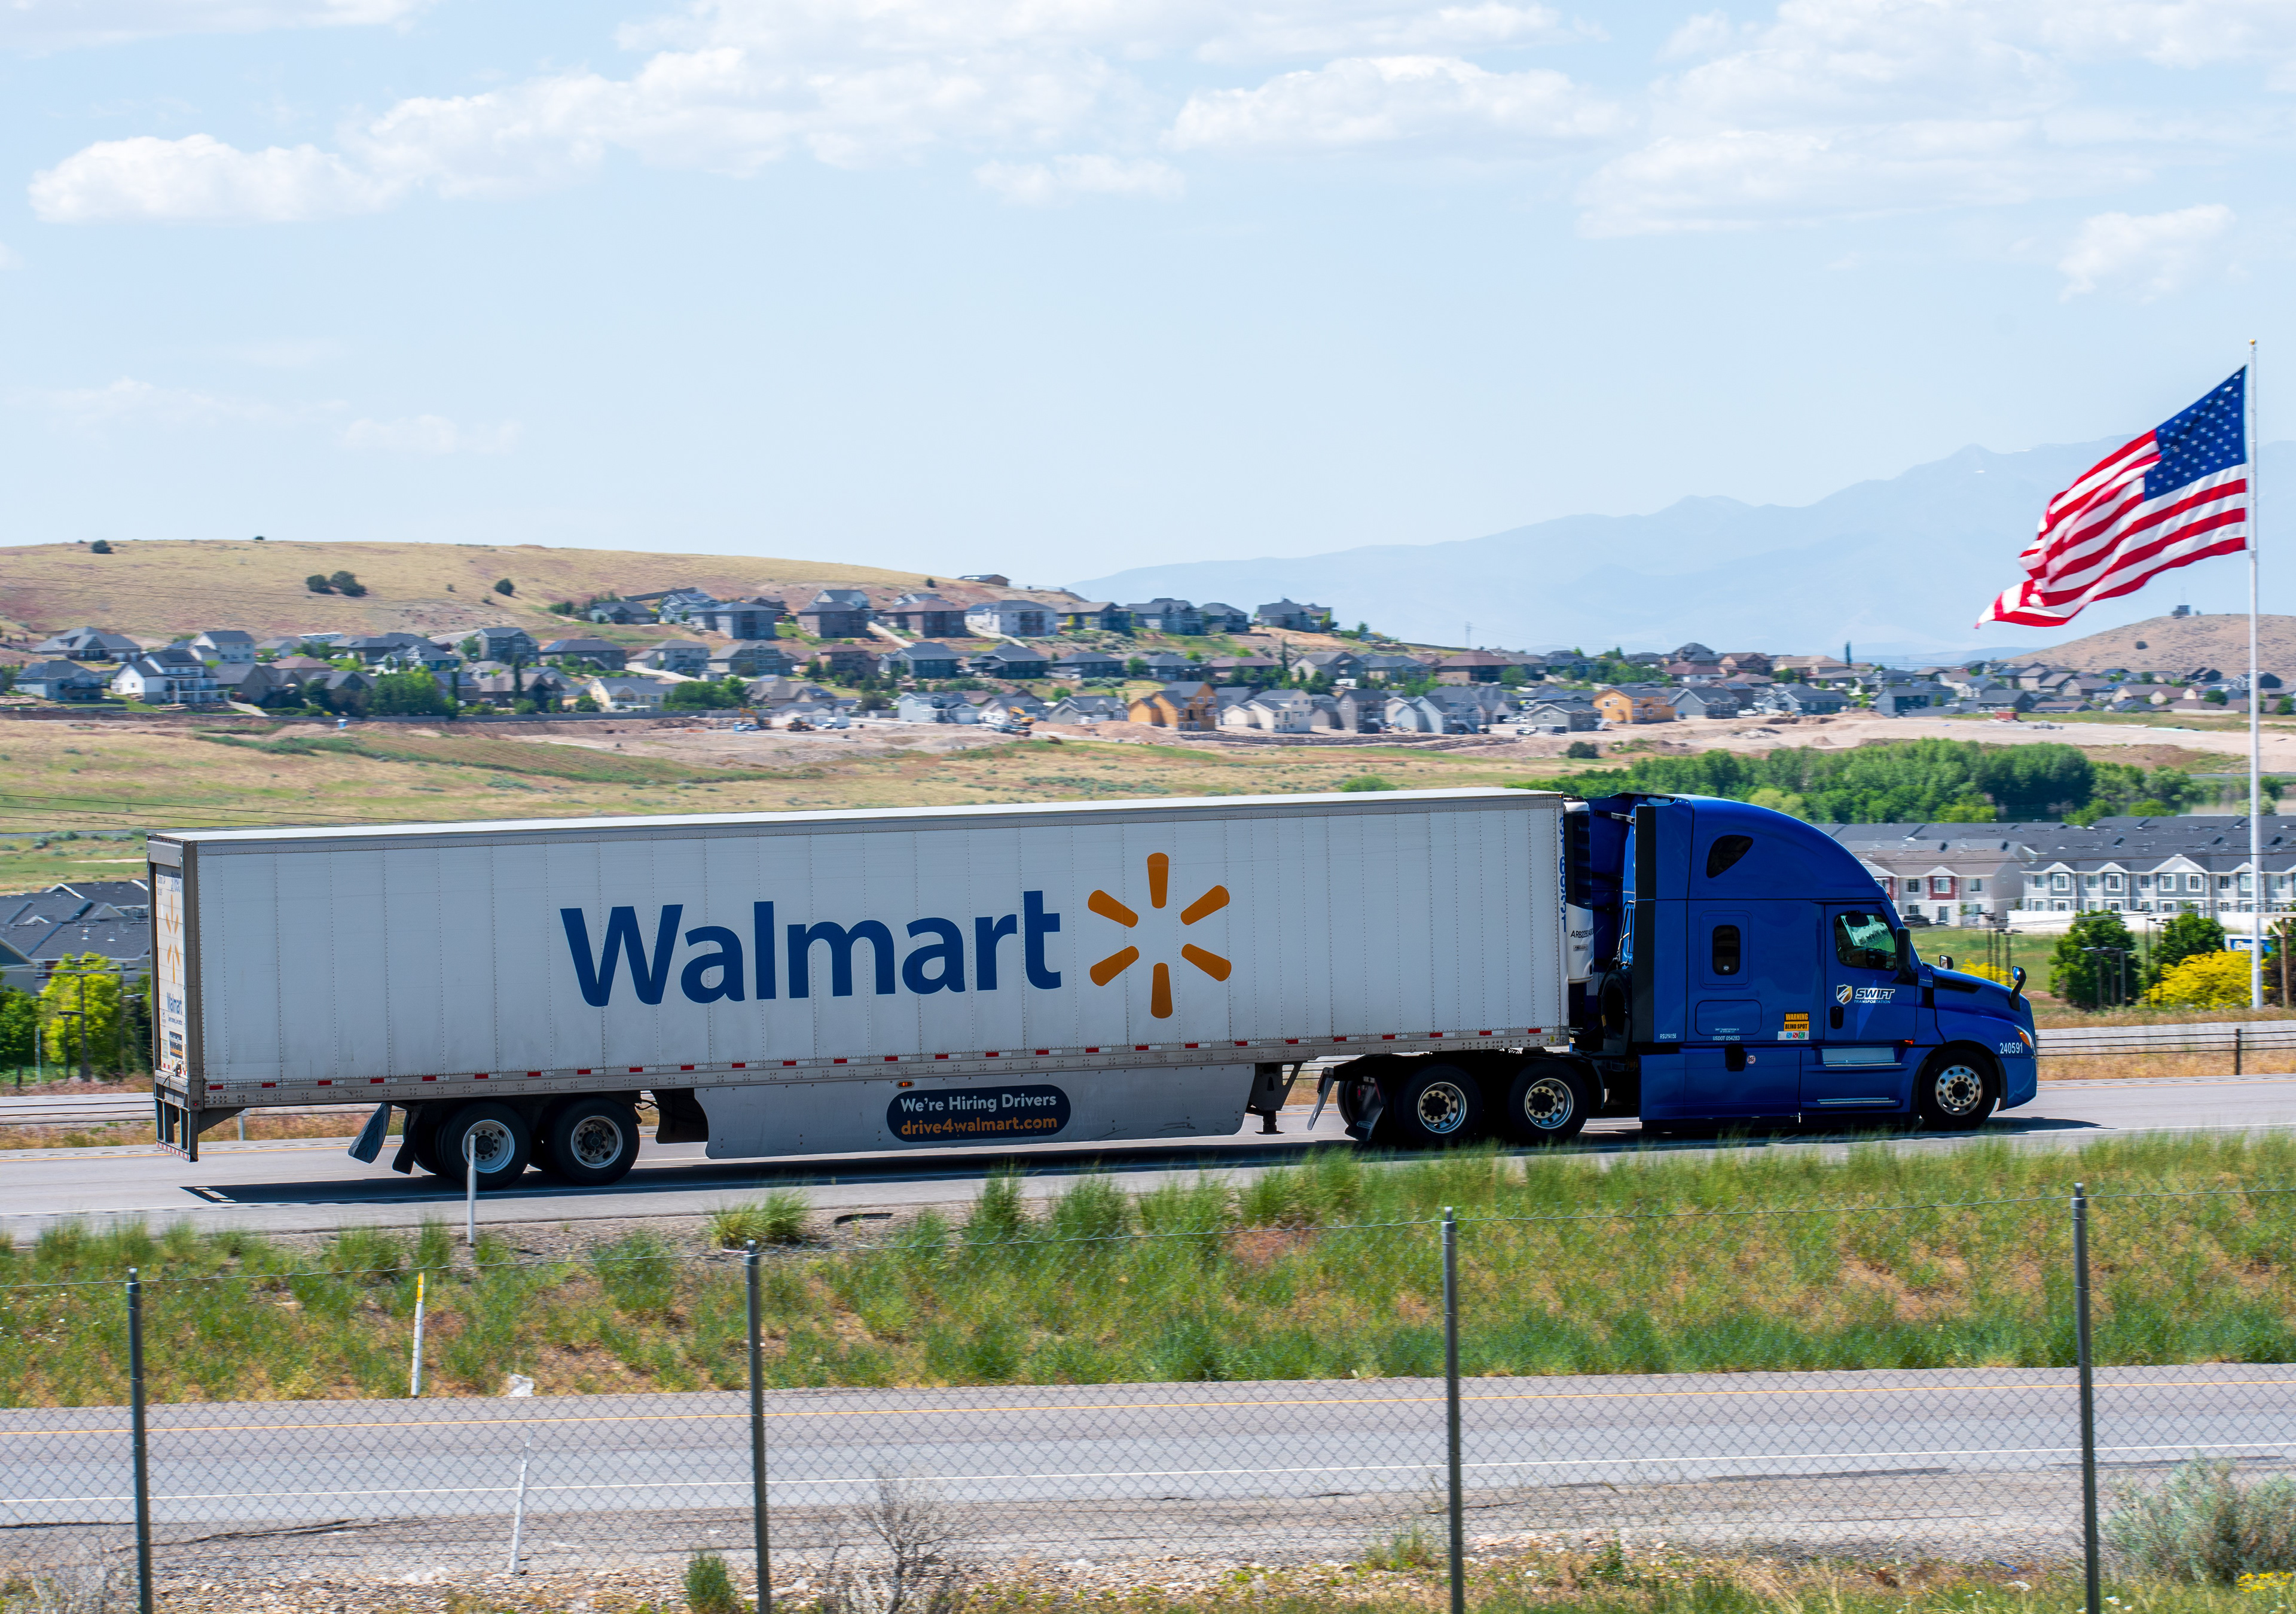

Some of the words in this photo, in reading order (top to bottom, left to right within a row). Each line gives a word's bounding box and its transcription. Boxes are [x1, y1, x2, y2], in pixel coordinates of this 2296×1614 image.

[560, 890, 1062, 1007] Walmart
[167, 991, 182, 1015] Walmart
[1855, 988, 1895, 999] SWIFT
[1999, 1042, 2023, 1054] 240591
[900, 1097, 944, 1112] We're
[949, 1096, 997, 1112] Hiring
[1002, 1093, 1057, 1107] Drivers
[901, 1116, 1058, 1136] drive4walmart.com
